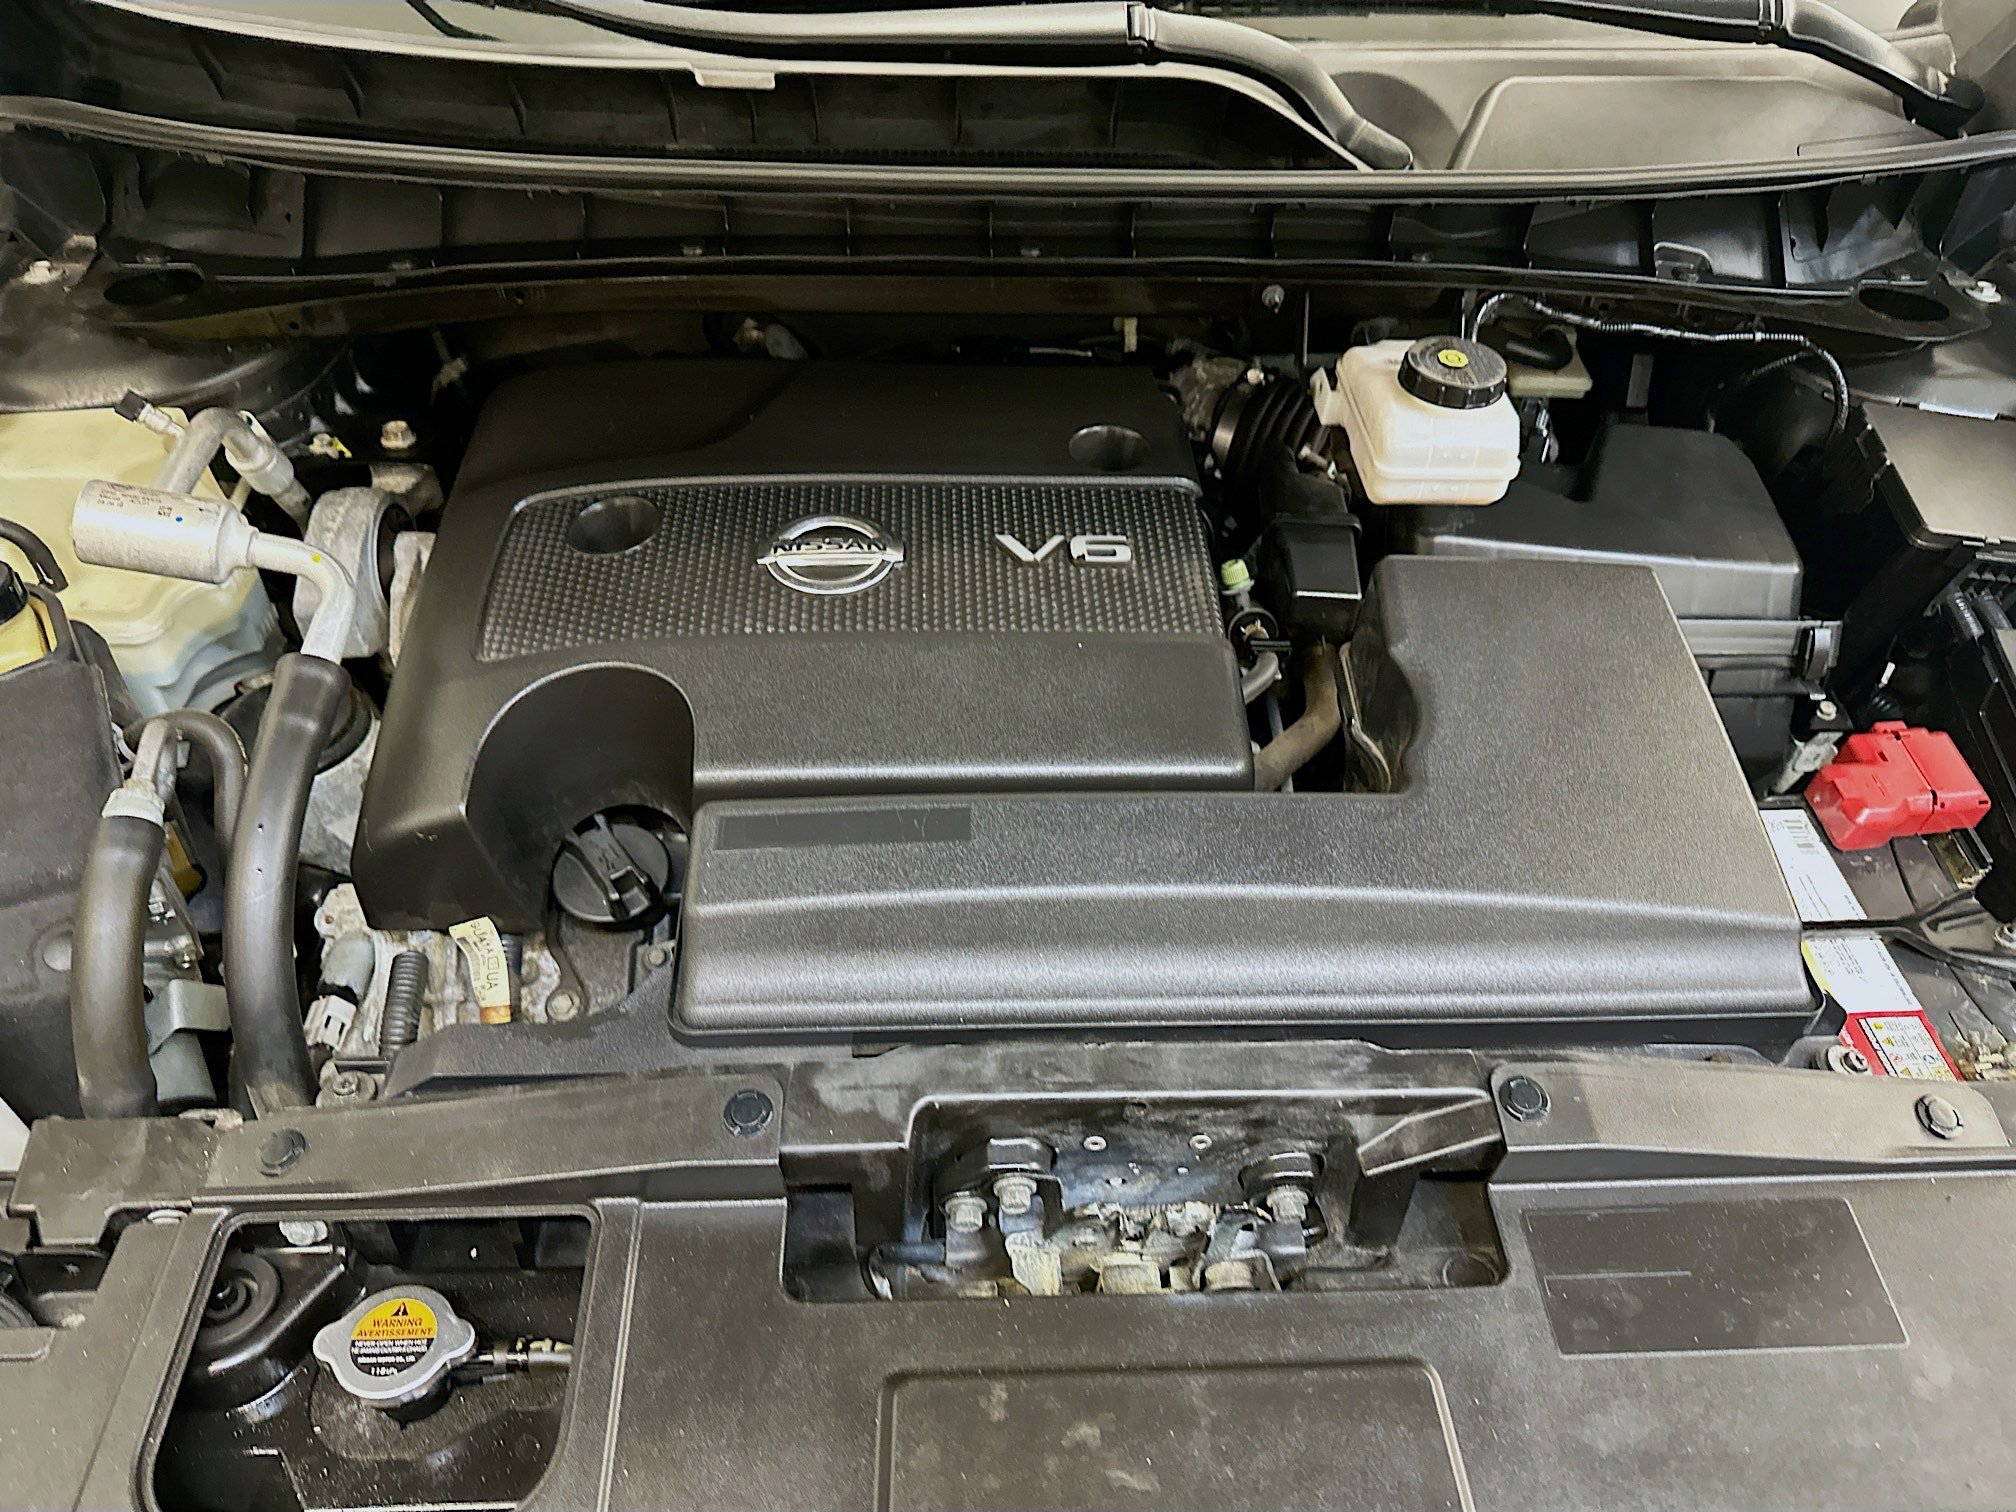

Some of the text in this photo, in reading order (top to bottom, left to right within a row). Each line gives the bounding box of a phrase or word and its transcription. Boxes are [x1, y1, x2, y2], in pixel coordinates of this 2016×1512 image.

[772, 538, 887, 554] NISSAN
[995, 534, 1132, 563] V6
[372, 1317, 424, 1328] WARNING
[356, 1328, 433, 1338] AVERTISSEMENT
